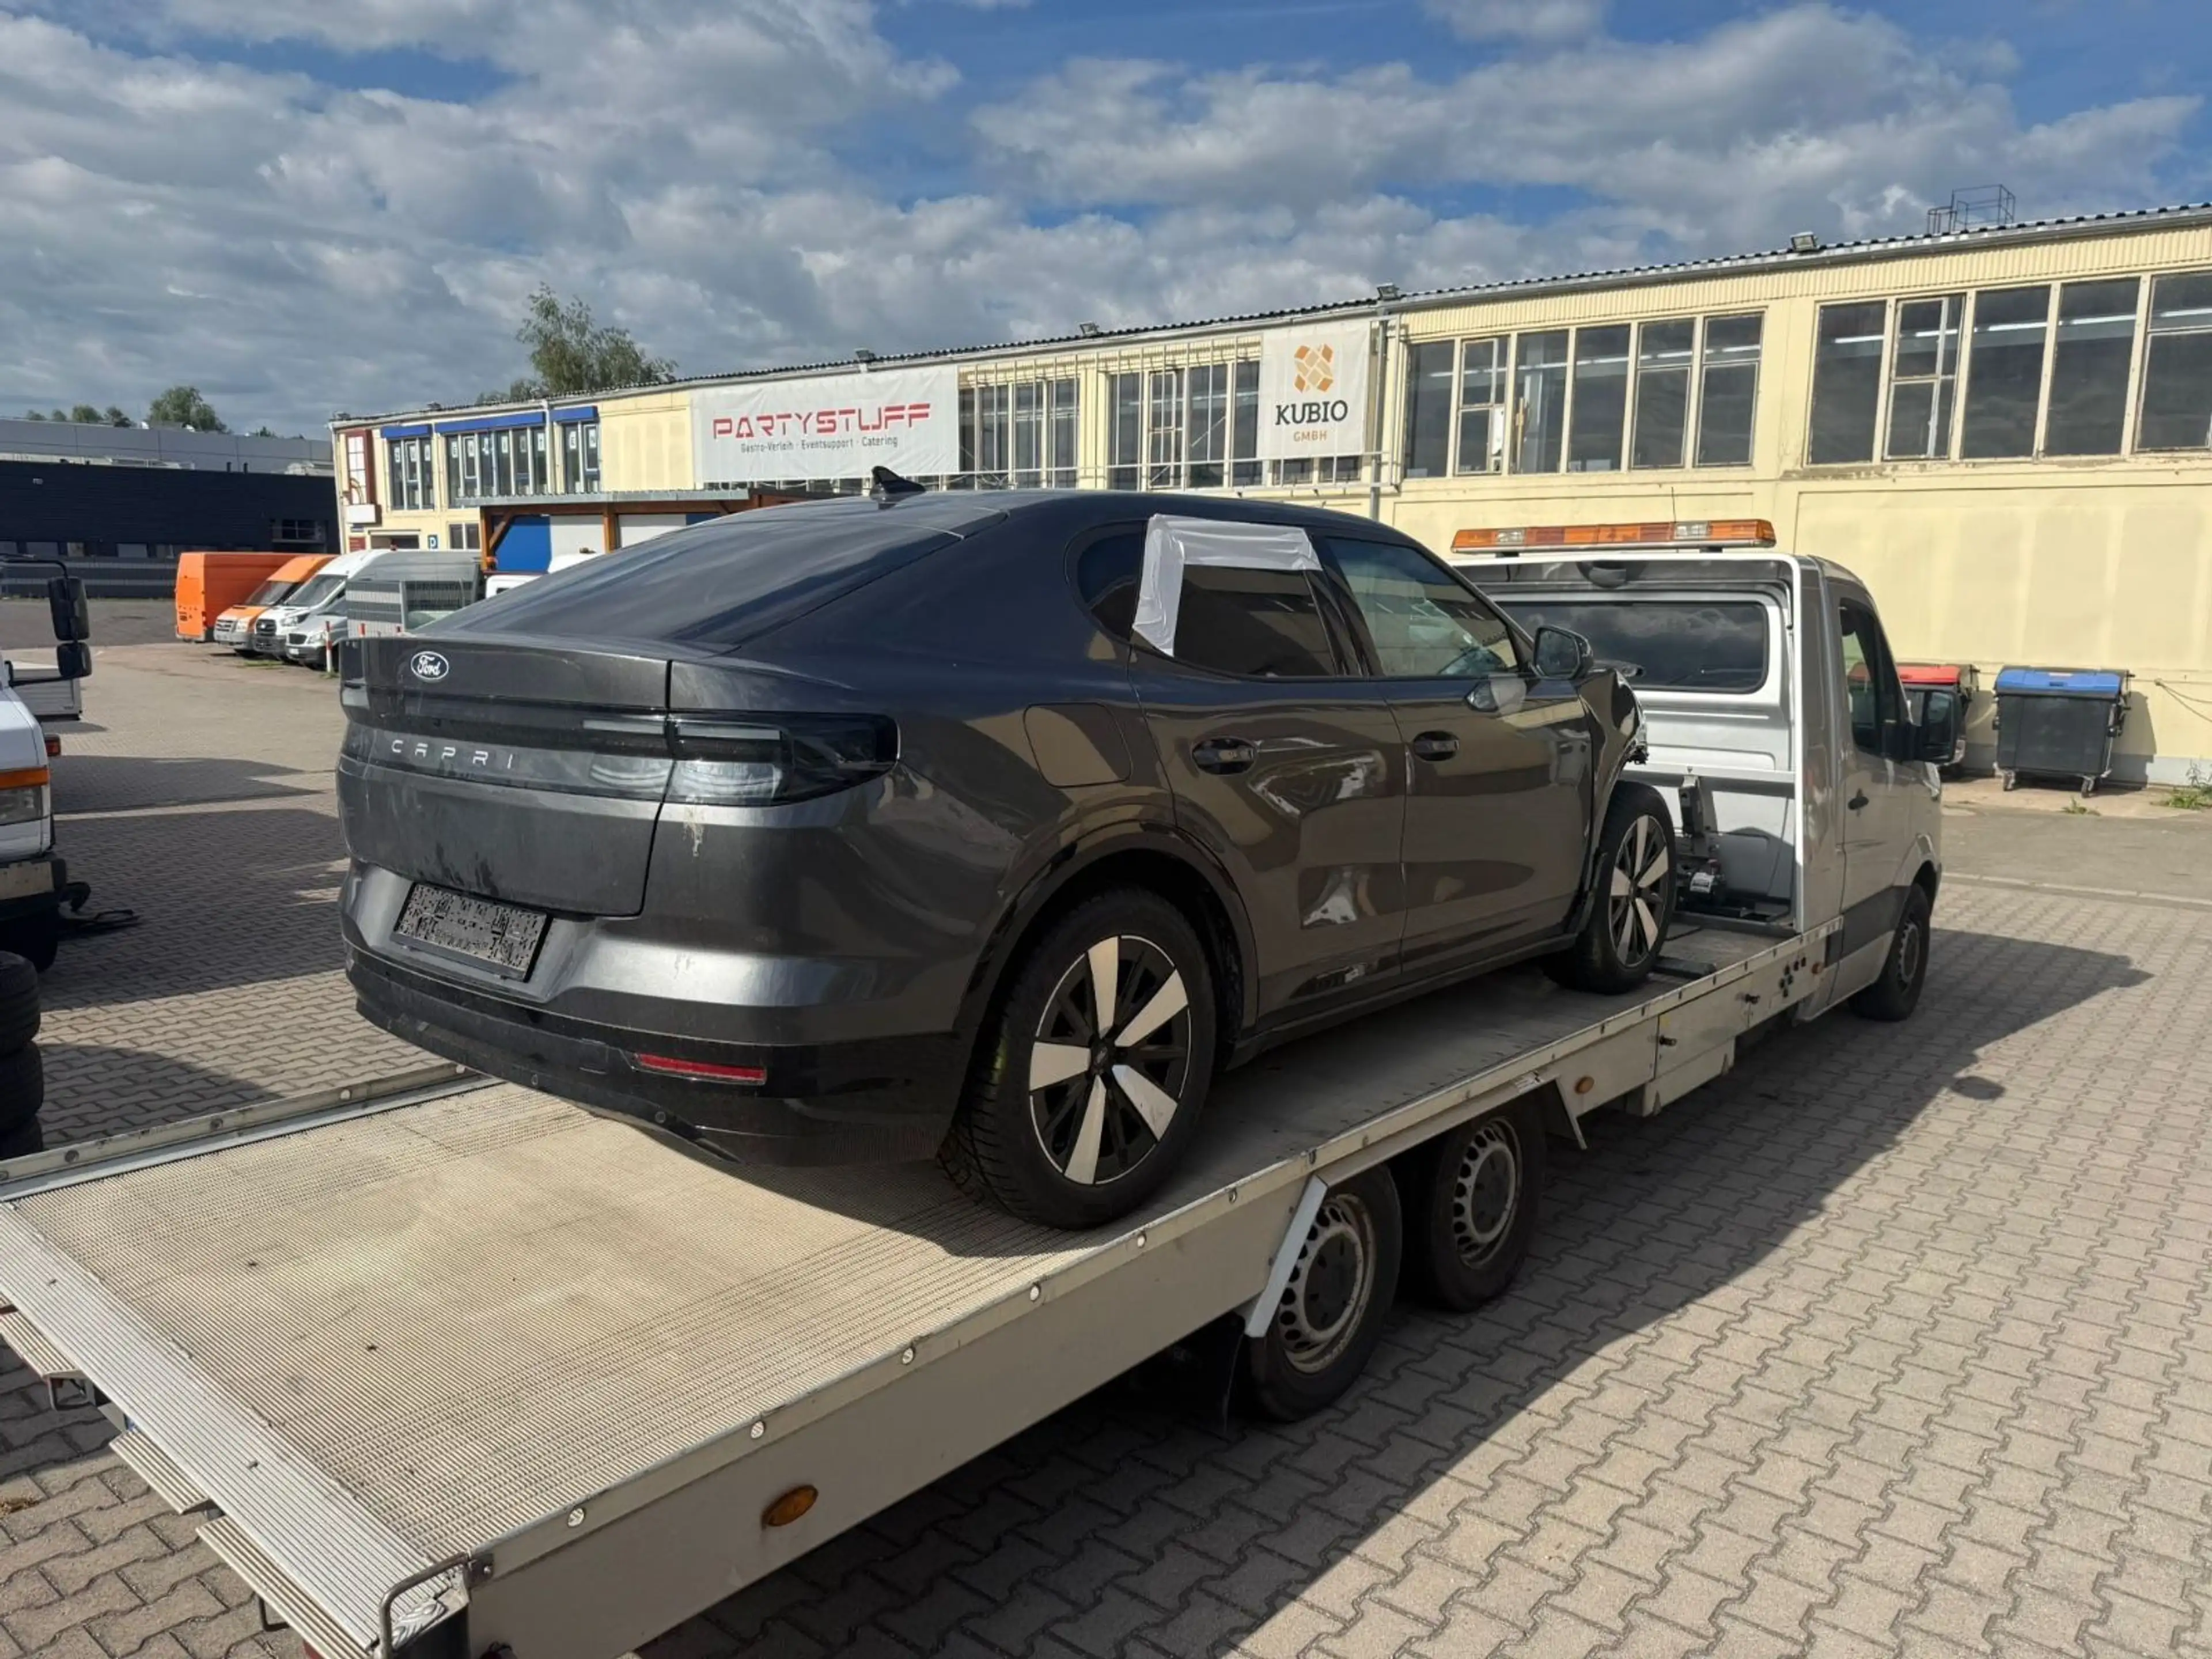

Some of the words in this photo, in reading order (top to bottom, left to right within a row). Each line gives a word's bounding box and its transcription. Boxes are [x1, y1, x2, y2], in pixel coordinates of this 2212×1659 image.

[713, 403, 931, 439] PARTYSTUFF
[1275, 400, 1349, 425] KUBIO
[801, 440, 854, 450] Eventsupport
[861, 436, 899, 448] Catering
[1293, 430, 1327, 442] GMBH
[417, 655, 441, 676] Ford
[391, 740, 513, 769] CAPRI
